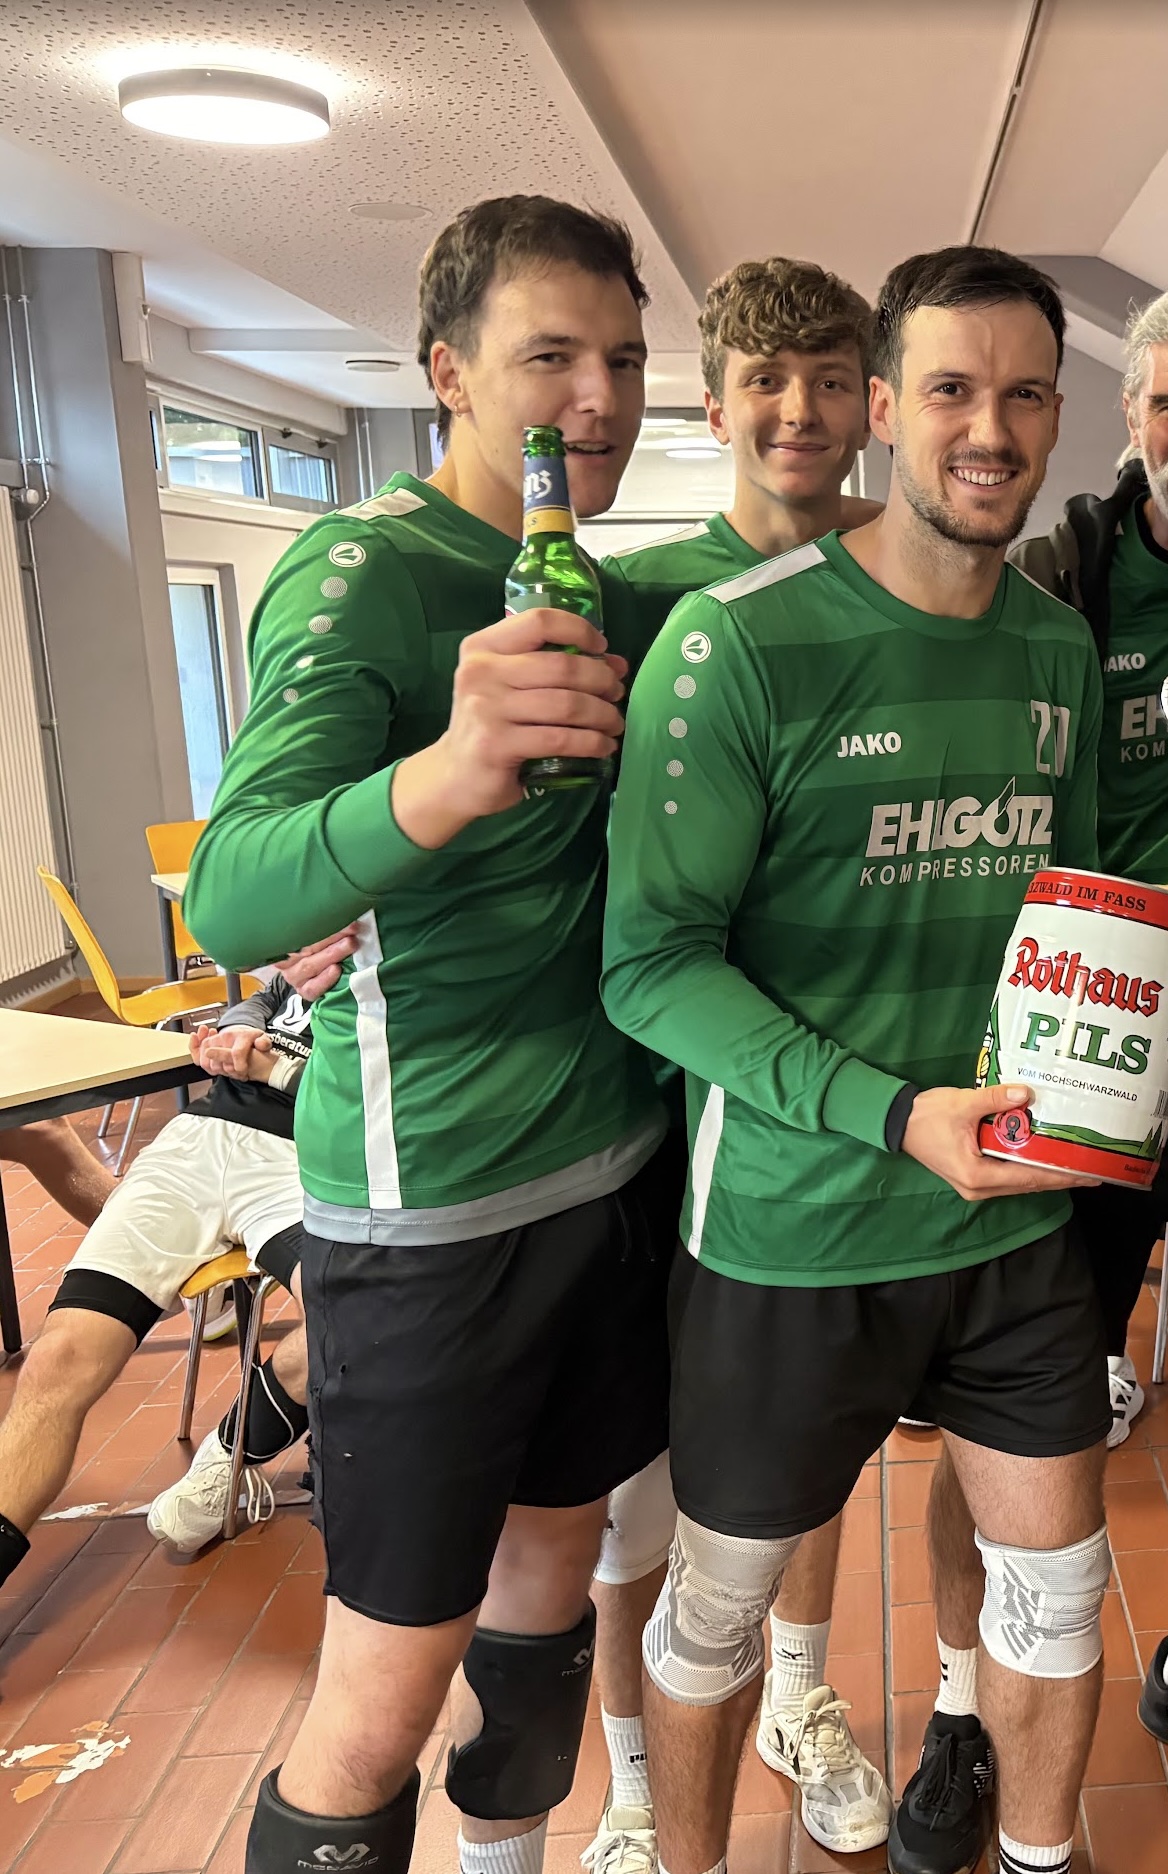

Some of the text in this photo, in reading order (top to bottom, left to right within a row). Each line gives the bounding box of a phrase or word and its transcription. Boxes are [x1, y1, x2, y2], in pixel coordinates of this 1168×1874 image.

[837, 731, 902, 758] JAKO
[859, 853, 1050, 887] KOMPRESSOREN
[1076, 886, 1099, 901] IM
[1102, 890, 1147, 912] FASS
[1007, 936, 1164, 1017] Rothaus
[1020, 1011, 1152, 1075] PILS
[1017, 1067, 1138, 1102] VOM HOCHSCHWARZWALD
